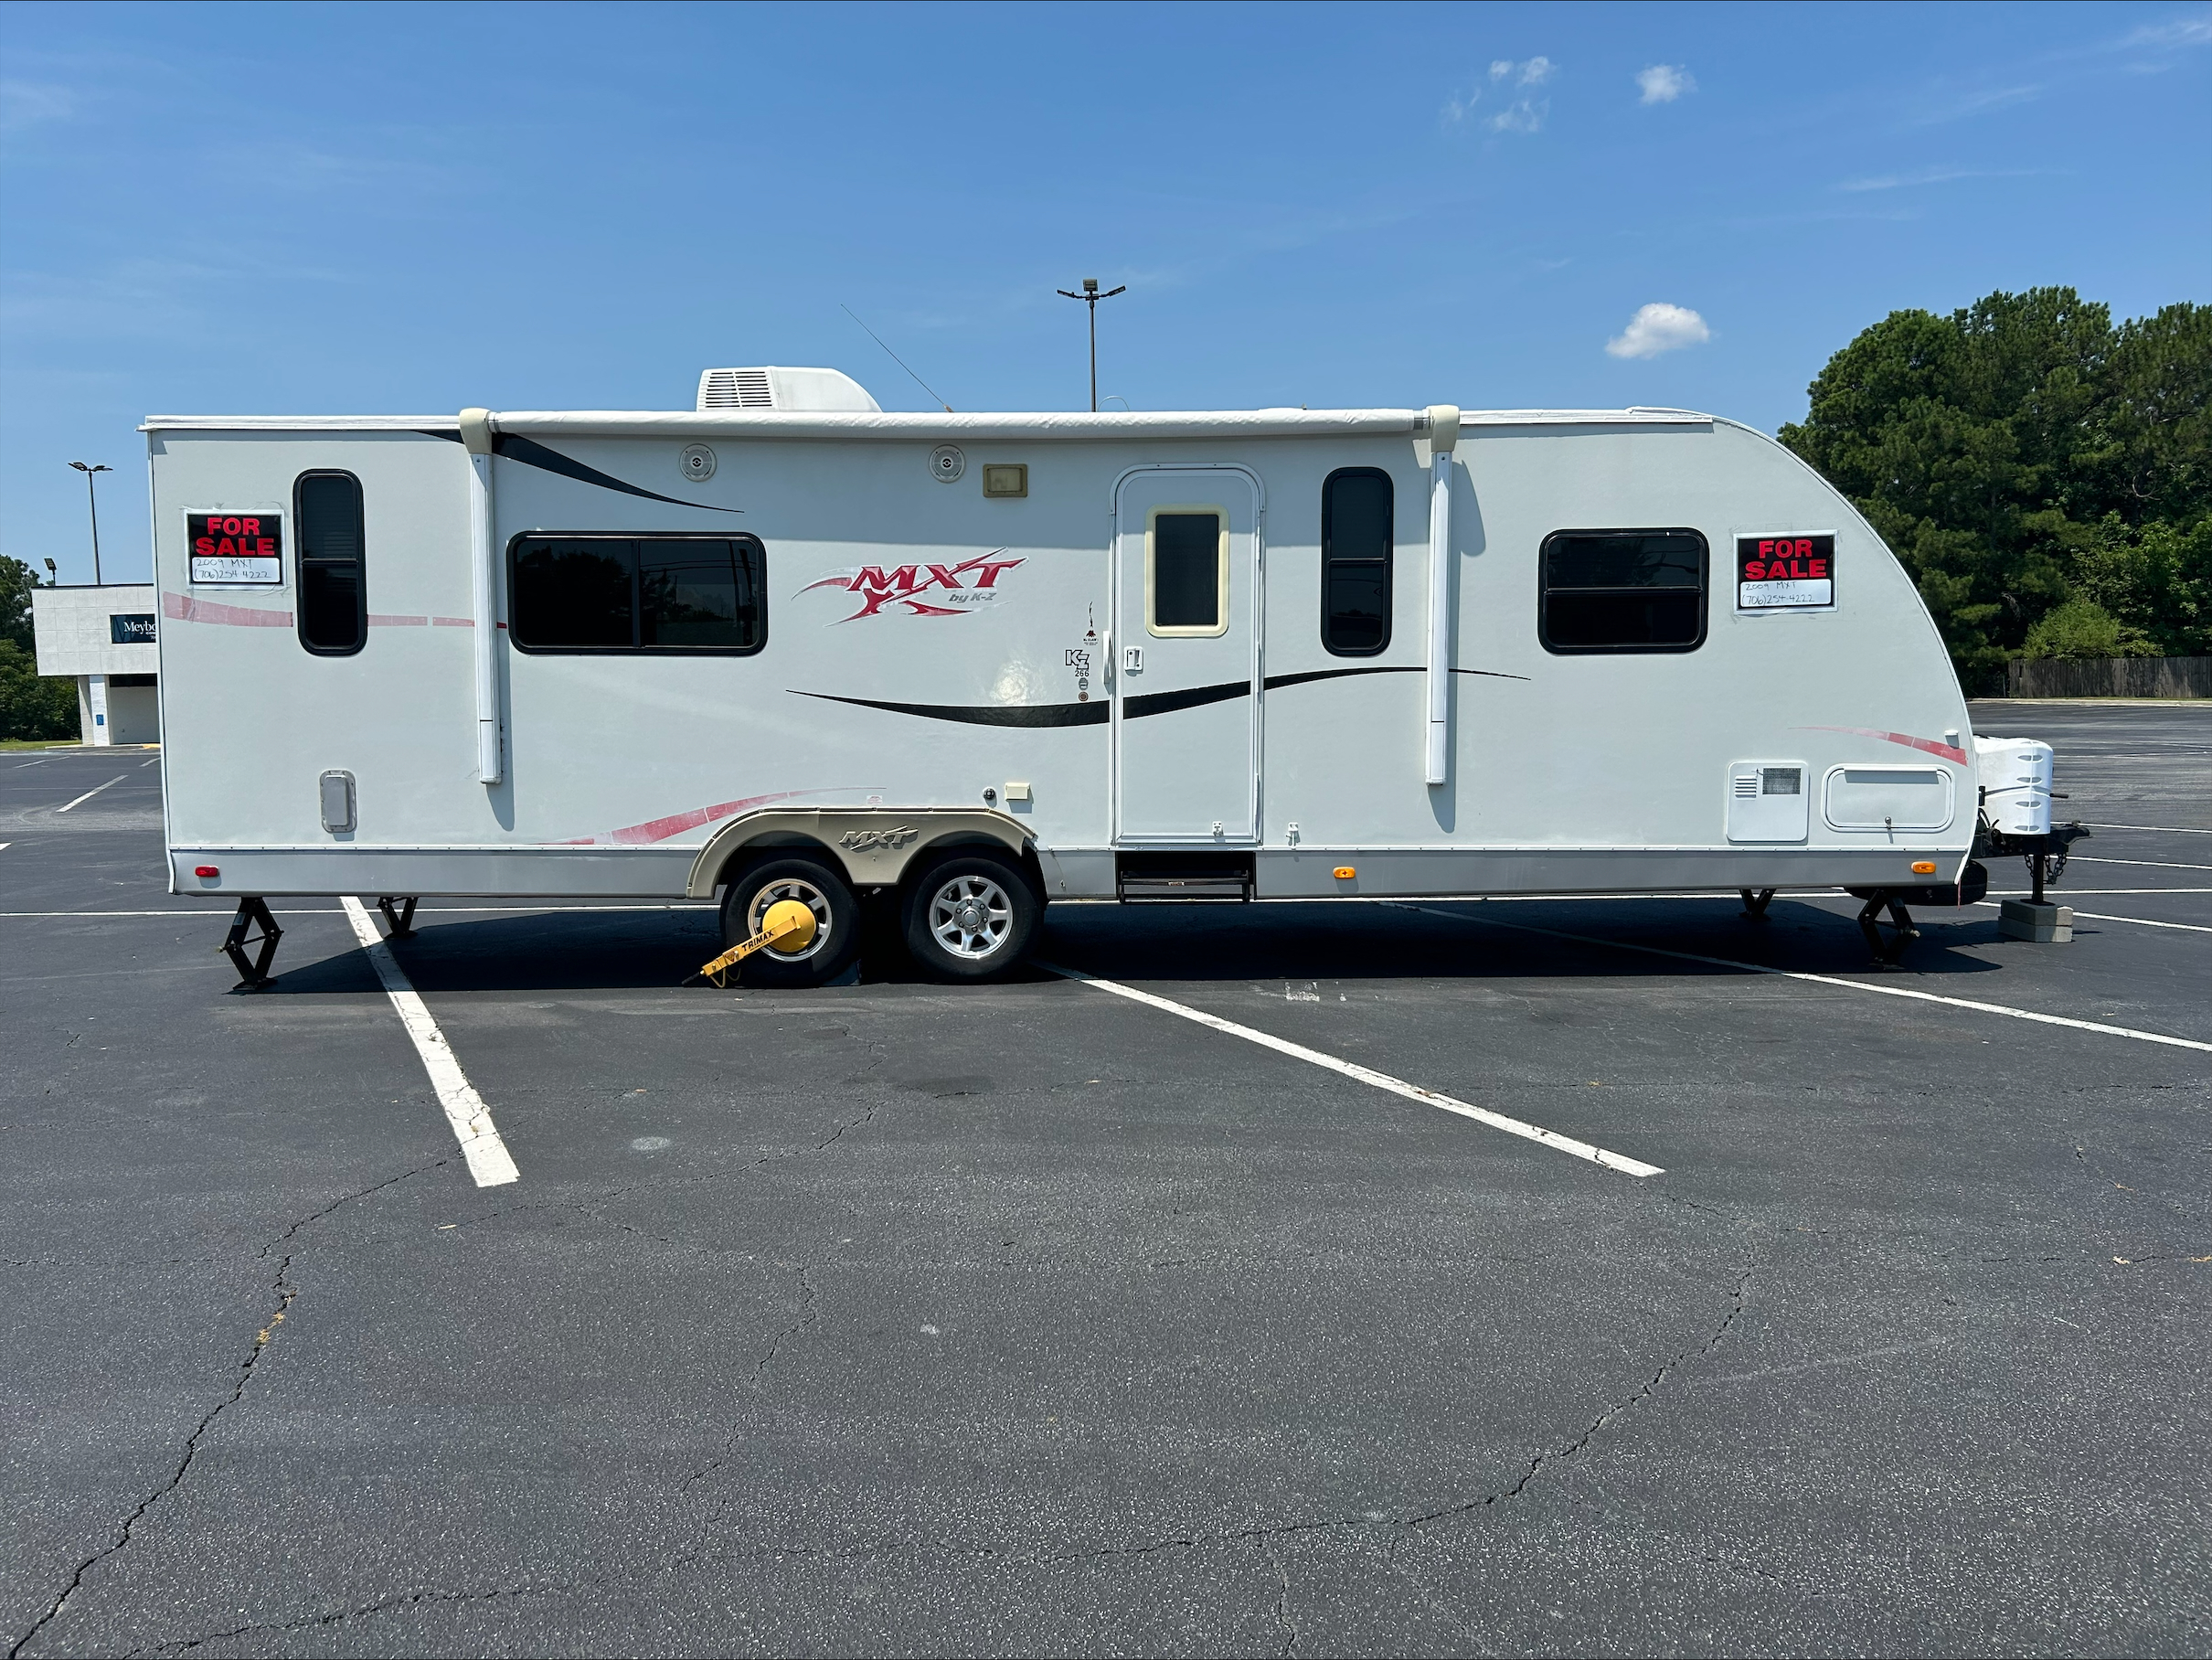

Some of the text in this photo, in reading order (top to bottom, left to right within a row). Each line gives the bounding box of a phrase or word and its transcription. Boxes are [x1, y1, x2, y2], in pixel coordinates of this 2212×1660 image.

[207, 517, 261, 536] FOR
[196, 537, 275, 556] SALE
[1759, 539, 1813, 559] FOR
[196, 559, 254, 569] 2009 MXT
[1744, 559, 1826, 580] SALE
[839, 547, 1029, 605] MXT
[1745, 581, 1797, 591] 2009 MXT
[949, 592, 996, 603] by K-Z
[838, 825, 919, 851] MXT
[741, 930, 774, 952] TRIMAX
